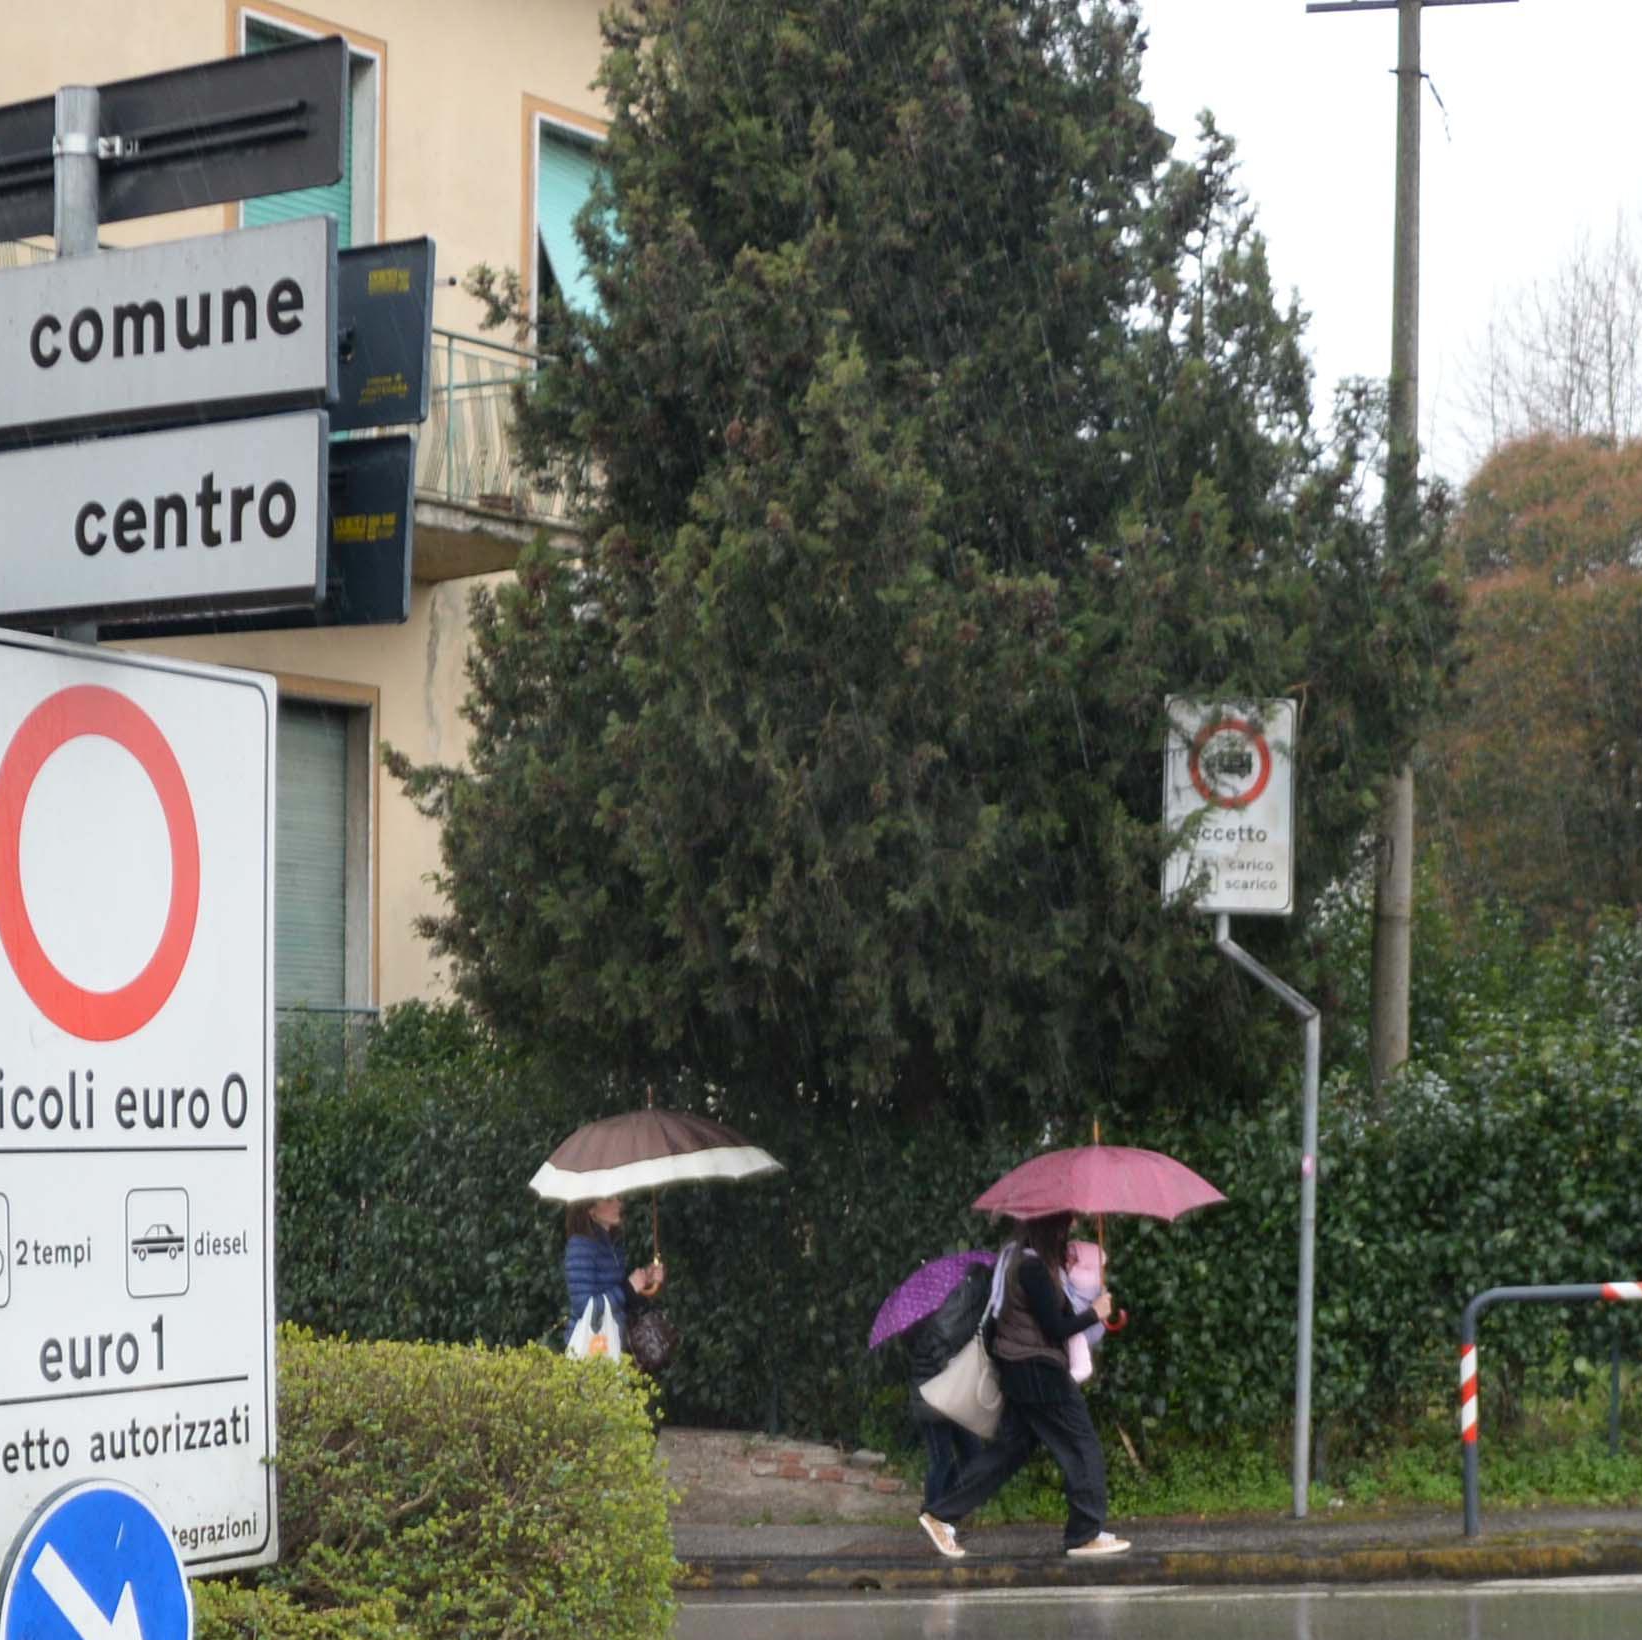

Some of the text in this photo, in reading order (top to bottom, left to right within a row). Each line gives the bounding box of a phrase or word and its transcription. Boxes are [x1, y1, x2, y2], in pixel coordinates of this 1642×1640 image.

[29, 277, 305, 369] comune
[74, 472, 298, 557] centro
[1199, 823, 1268, 843] ccetto
[1224, 878, 1278, 891] scarico
[1227, 858, 1275, 872] carico
[114, 1086, 211, 1131] euro
[220, 1072, 249, 1130] 0
[14, 1237, 92, 1269] 2 tempi
[193, 1230, 249, 1258] diesel
[39, 1314, 165, 1383] euro 1
[89, 1404, 251, 1464] autorizzati
[170, 1511, 258, 1551] tegrazioni
